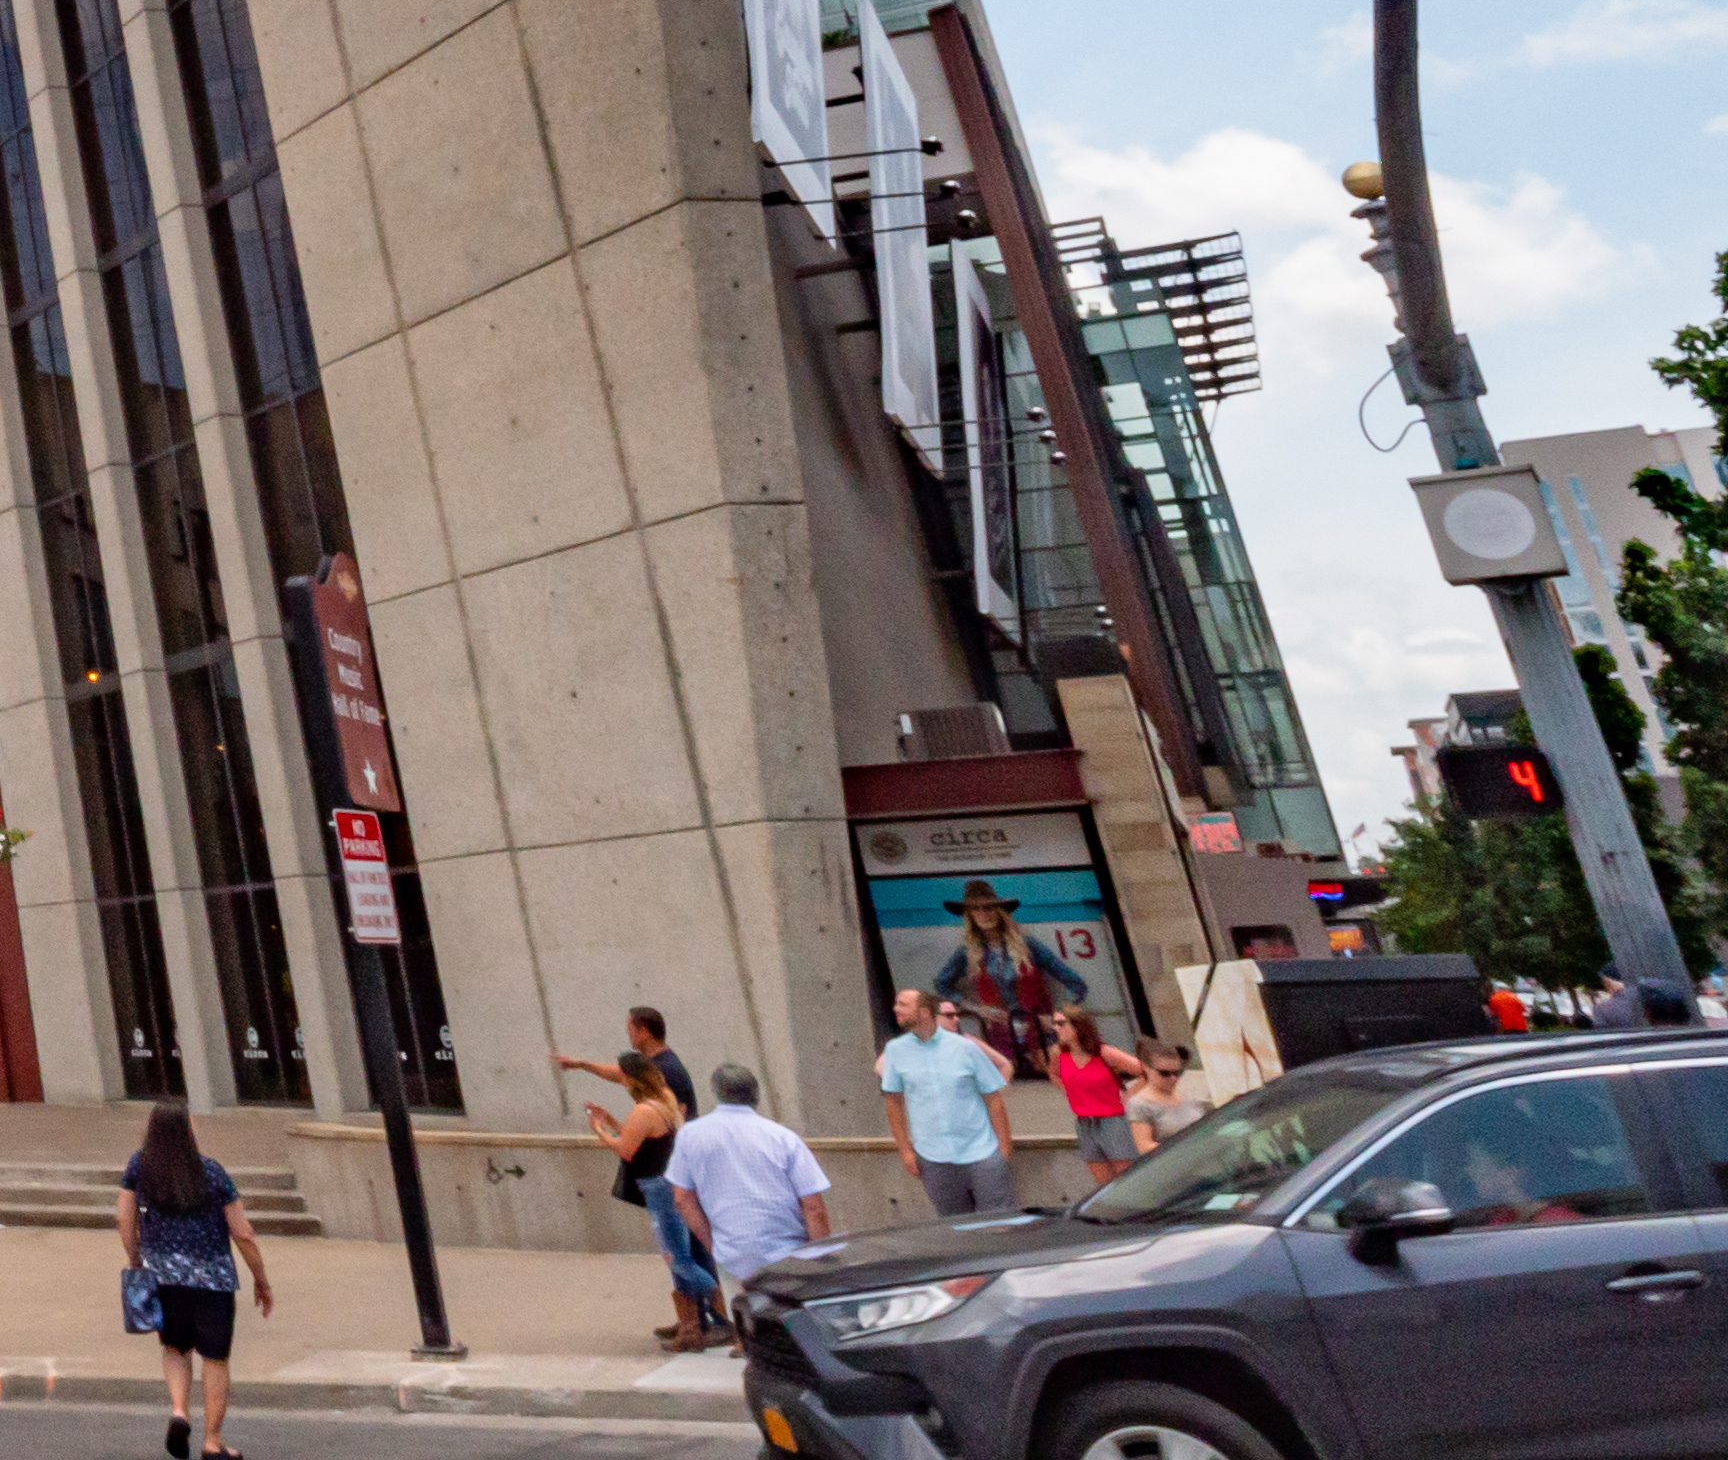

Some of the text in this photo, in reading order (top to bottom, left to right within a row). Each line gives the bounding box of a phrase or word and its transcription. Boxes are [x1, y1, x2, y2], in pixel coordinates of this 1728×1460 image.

[327, 627, 363, 664] Country
[337, 662, 364, 690] Music
[331, 692, 352, 718] Hall
[1509, 761, 1543, 801] 4
[351, 819, 366, 837] NO
[930, 827, 1008, 846] circa
[343, 838, 382, 857] PARKING
[1054, 927, 1097, 960] 13
